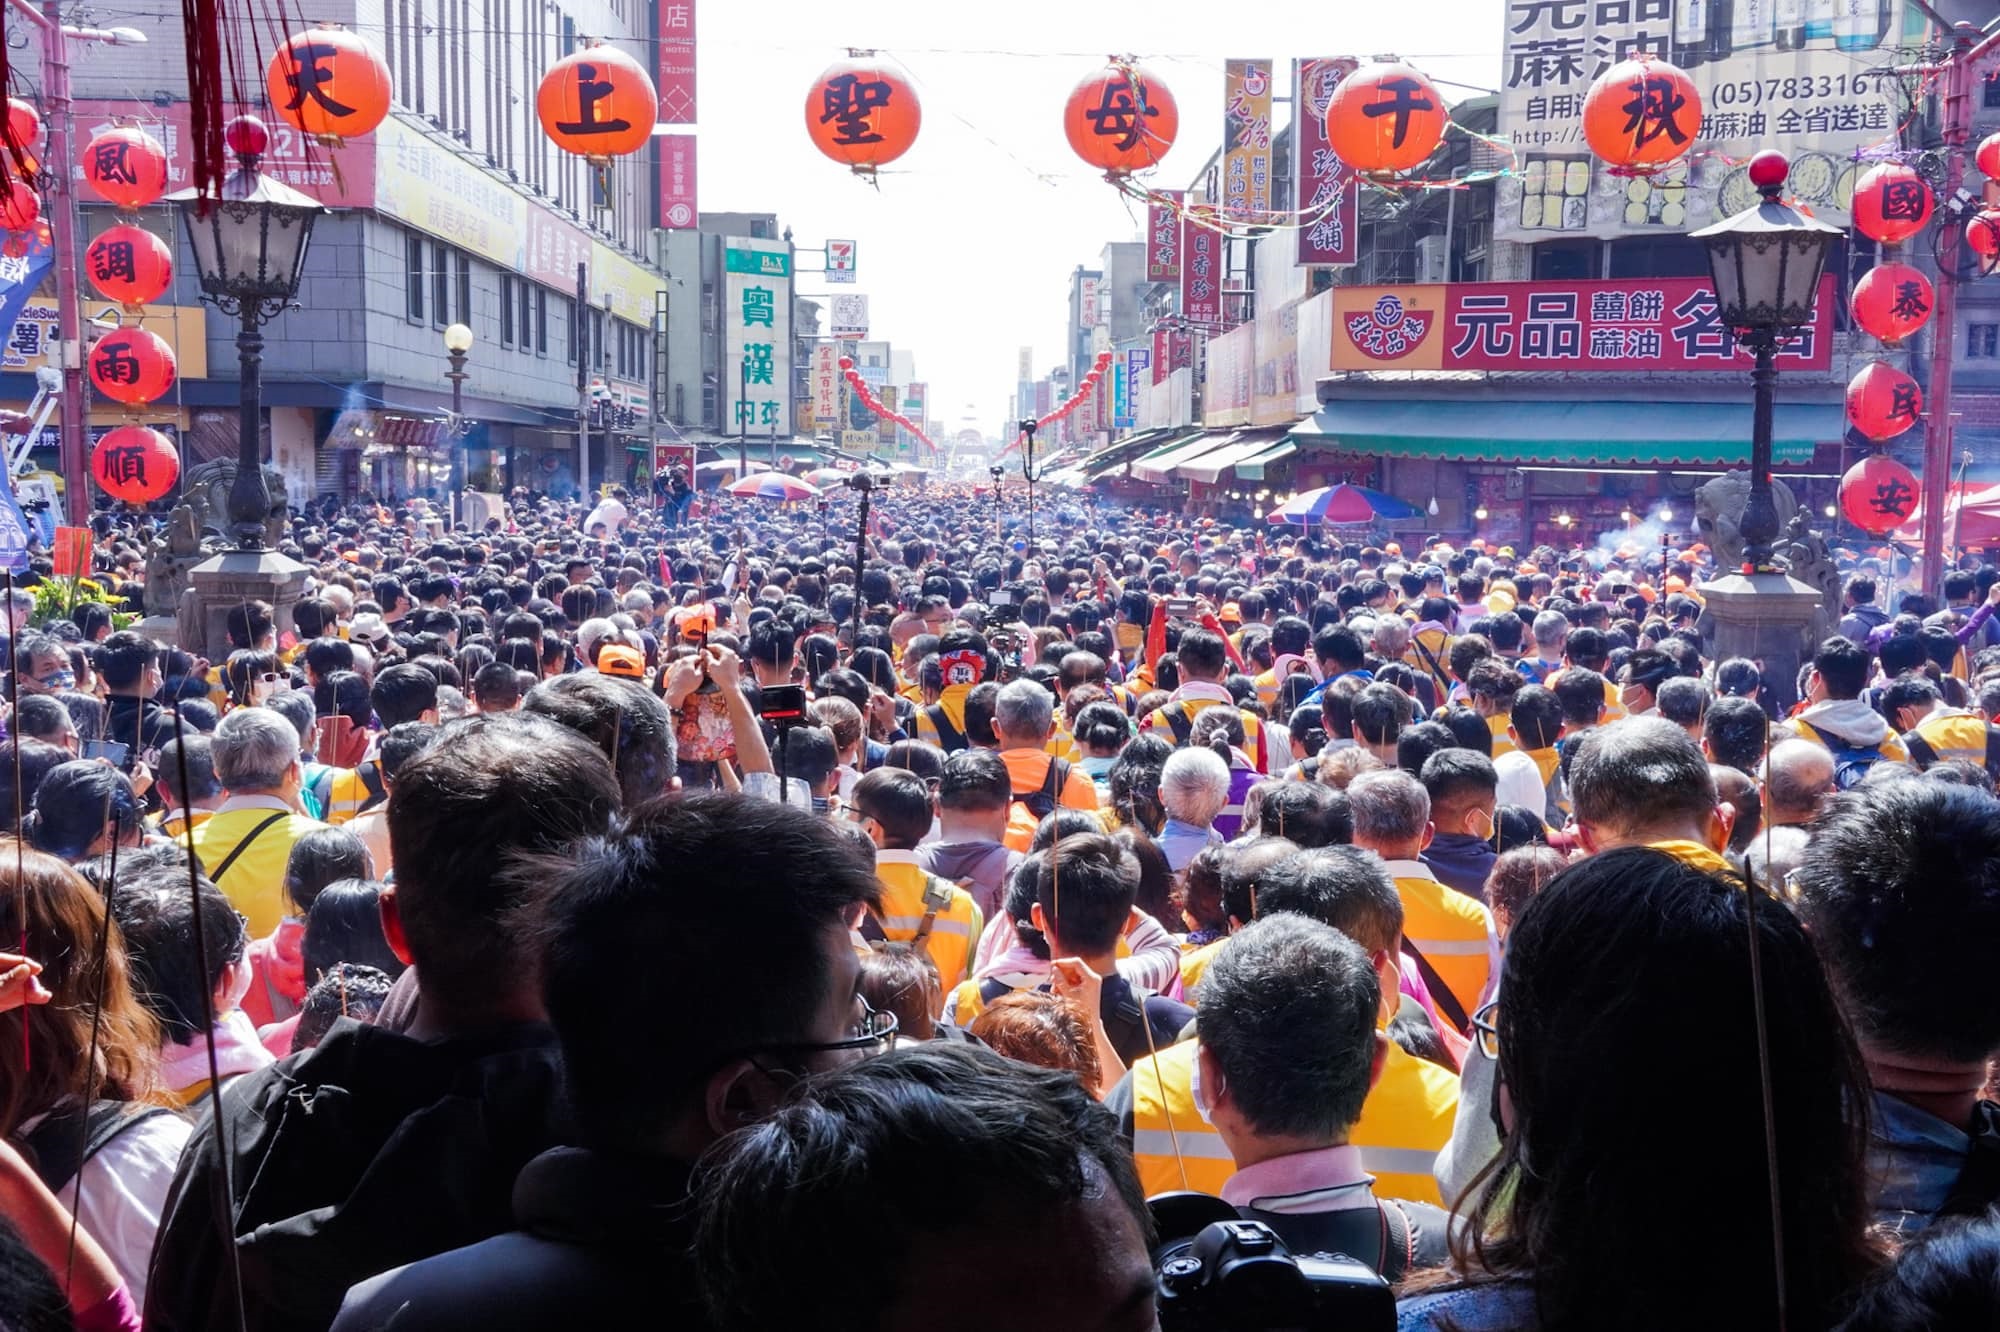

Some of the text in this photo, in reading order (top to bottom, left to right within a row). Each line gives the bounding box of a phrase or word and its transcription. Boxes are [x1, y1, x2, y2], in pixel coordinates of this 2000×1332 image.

[665, 3, 689, 28] 店
[285, 43, 1689, 151] 天 上 聖 母 千 秋
[1776, 102, 1888, 136] 全省送達
[91, 141, 148, 487] 風 調 雨 順
[742, 285, 774, 385] 賓漢
[1452, 294, 1583, 359] 元品
[1869, 180, 1929, 517] 國 泰 民 安
